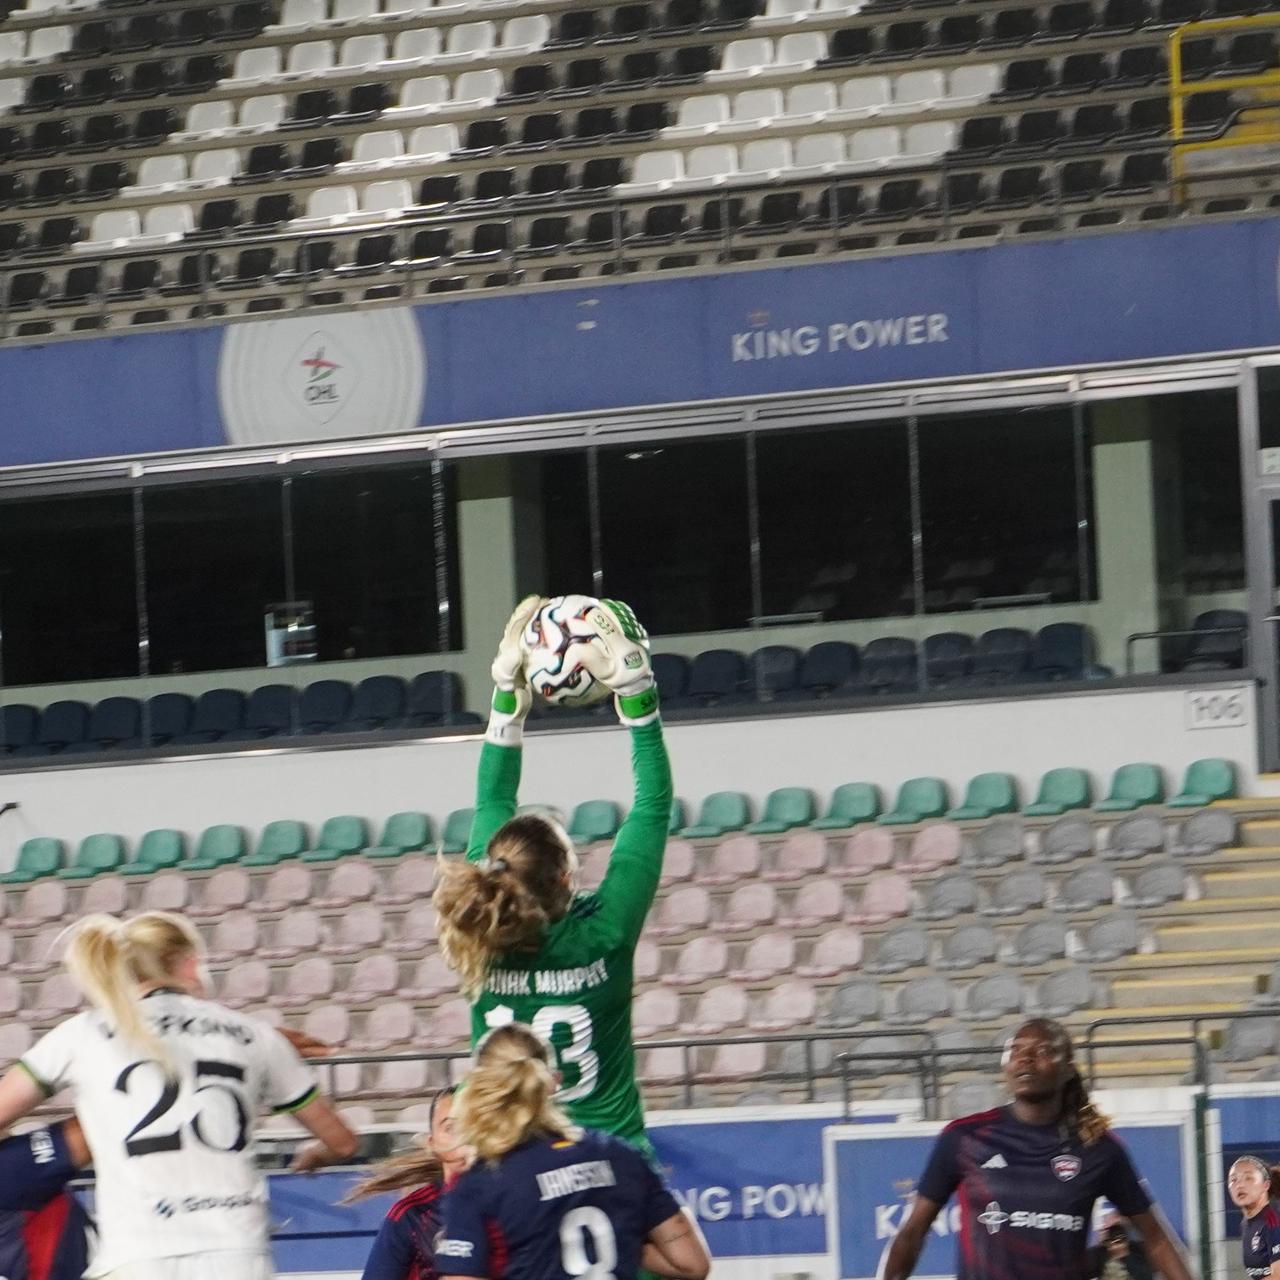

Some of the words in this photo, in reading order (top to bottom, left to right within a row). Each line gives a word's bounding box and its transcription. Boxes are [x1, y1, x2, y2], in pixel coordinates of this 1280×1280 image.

[731, 325, 820, 362] KING
[828, 313, 949, 352] POWER
[115, 1060, 247, 1157] 25
